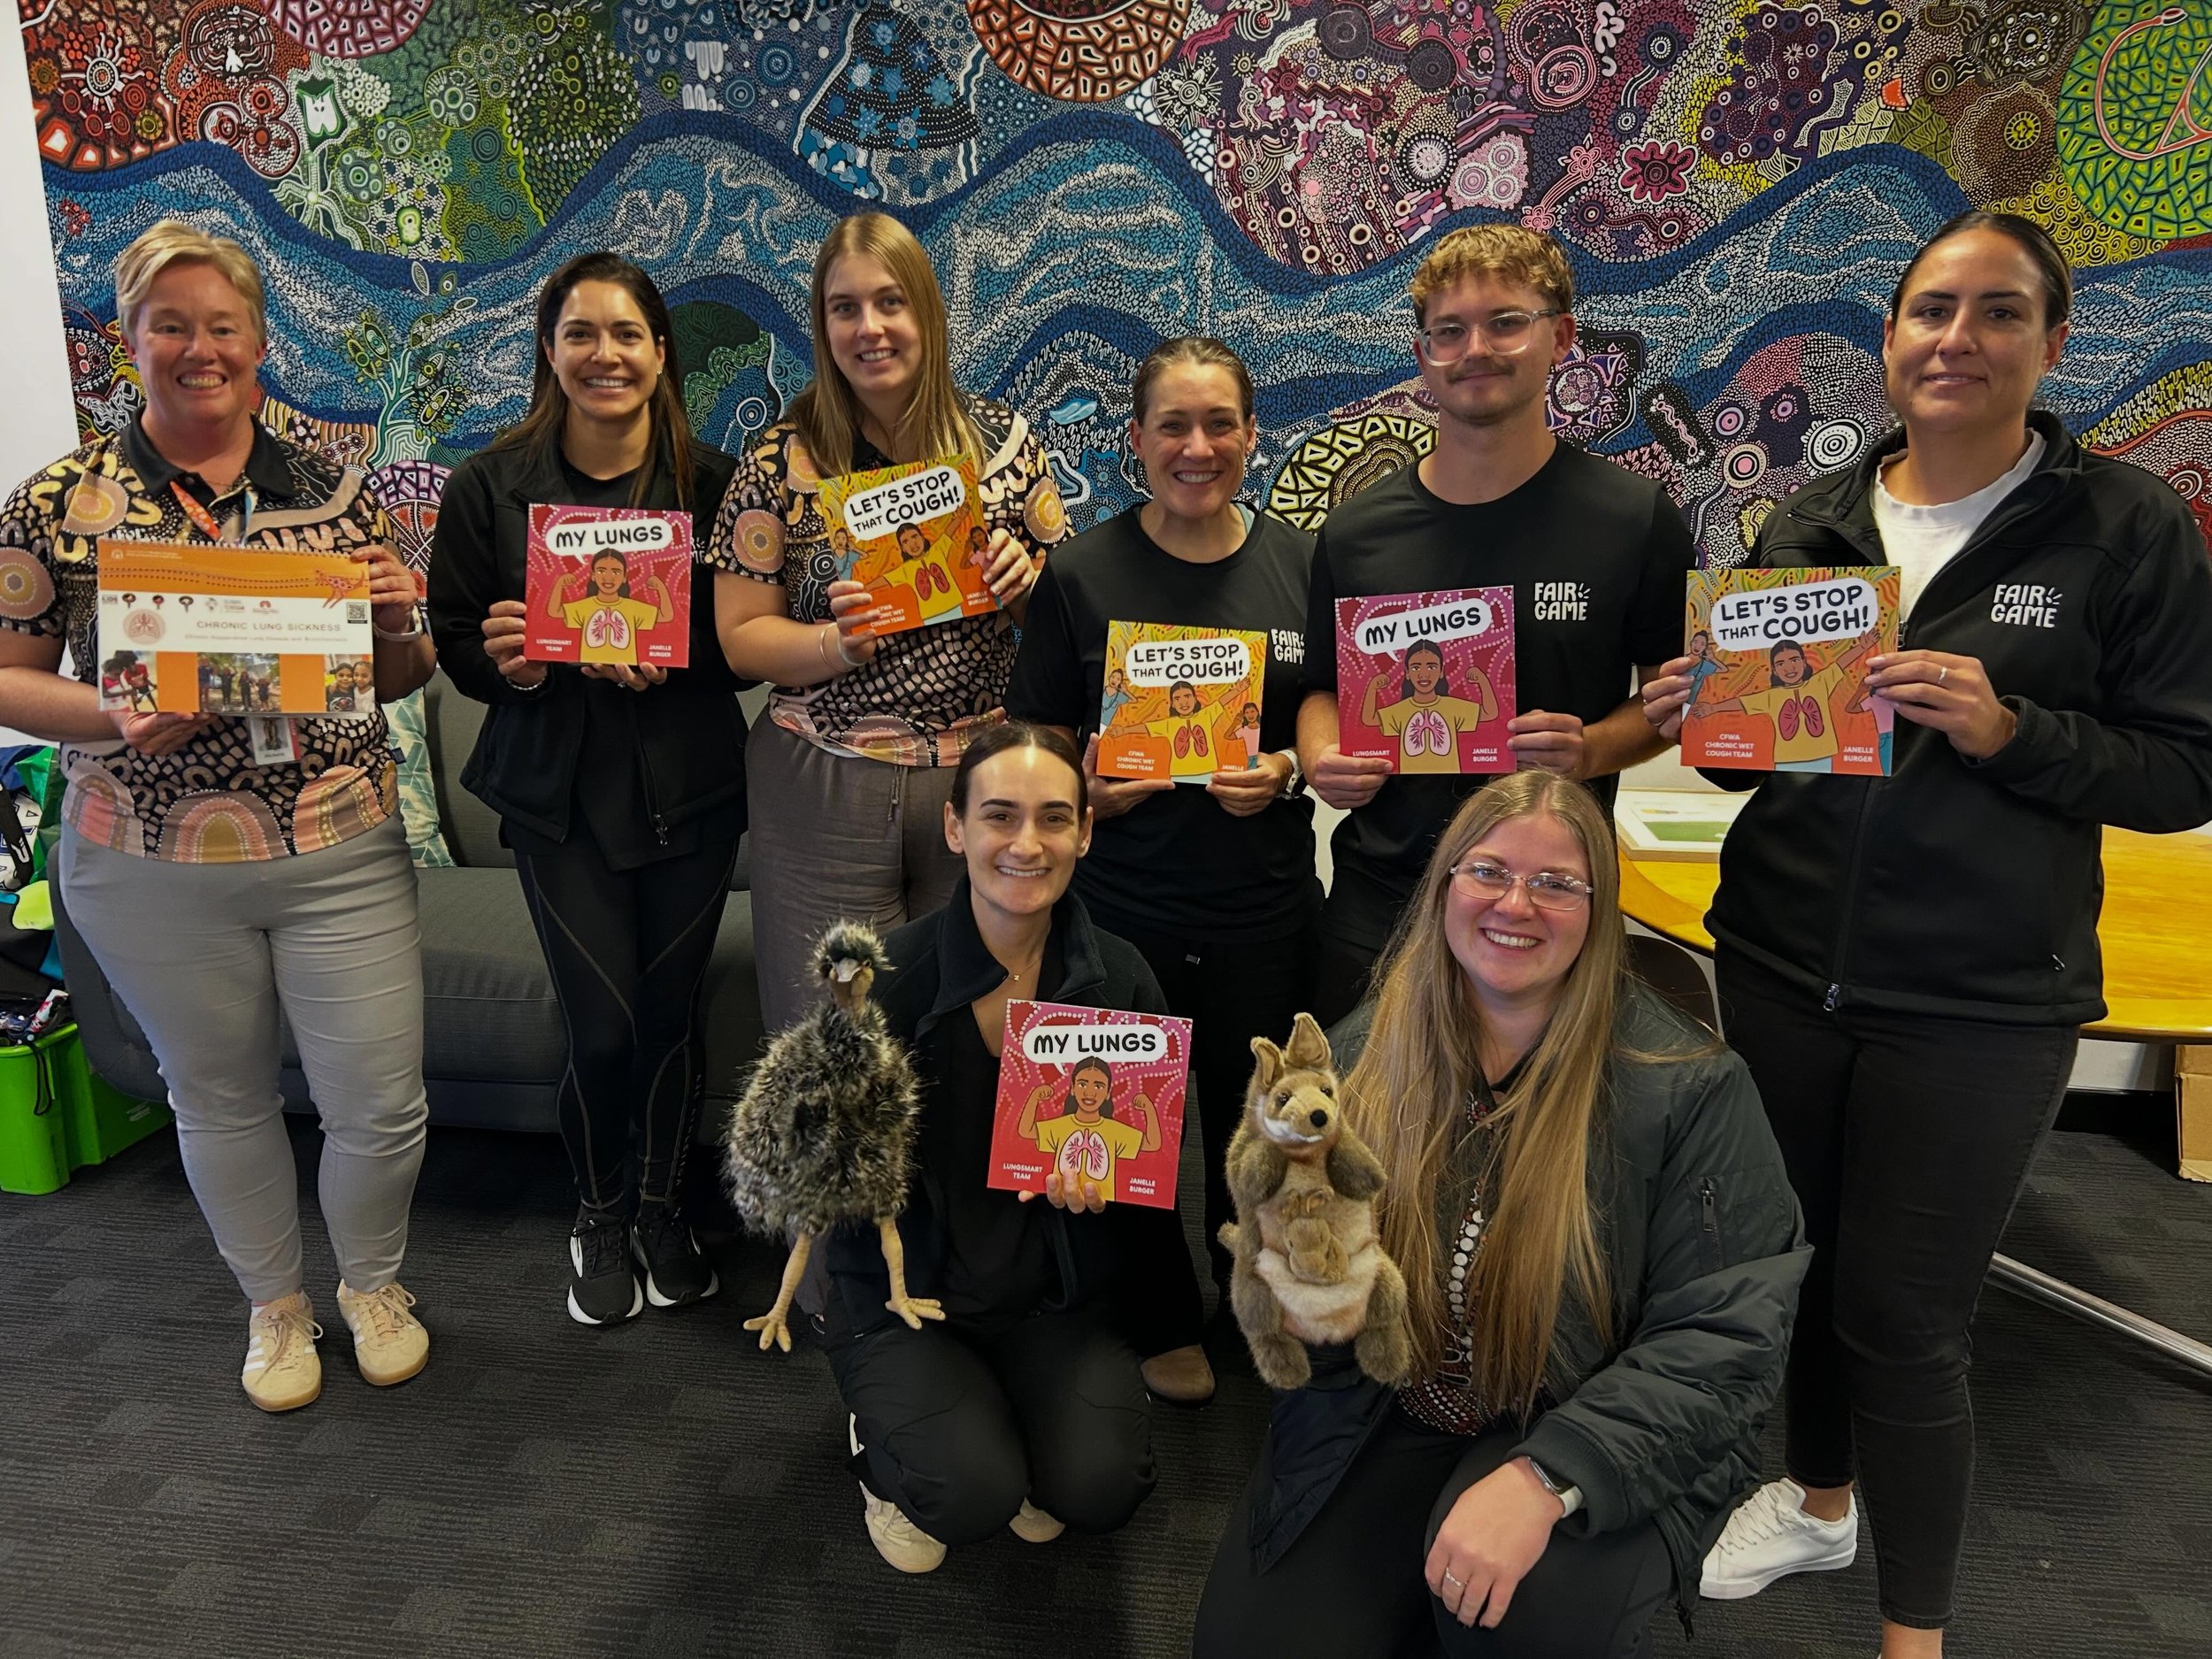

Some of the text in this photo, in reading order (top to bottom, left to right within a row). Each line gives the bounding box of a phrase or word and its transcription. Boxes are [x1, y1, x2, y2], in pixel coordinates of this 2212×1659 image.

[849, 471, 950, 517] LET'S STOP
[854, 486, 960, 533] THAT COUGH!
[557, 526, 663, 548] MY LUNGS
[1534, 582, 1577, 602] FAIR
[1993, 584, 2046, 606] FAIR
[1534, 602, 1588, 621] GAME
[1721, 585, 1863, 621] LET'S STOP
[196, 620, 341, 632] CHRONIC LUNG SICKNESS
[1718, 605, 1869, 641] THAT COUGH!
[1991, 603, 2057, 628] GAME
[1366, 607, 1481, 647] MY LUNGS
[1271, 628, 1301, 648] FAIR
[1134, 644, 1240, 663] LET'S STOP
[1274, 644, 1305, 665] GAM
[1132, 659, 1243, 680] THAT COUGH!
[1033, 1033, 1156, 1054] MY LUNGS
[1002, 1162, 1043, 1173] LUNGSMART
[1013, 1171, 1032, 1180] TEAM
[1129, 1177, 1156, 1187] JANELLE
[1129, 1185, 1156, 1195] BURGER
